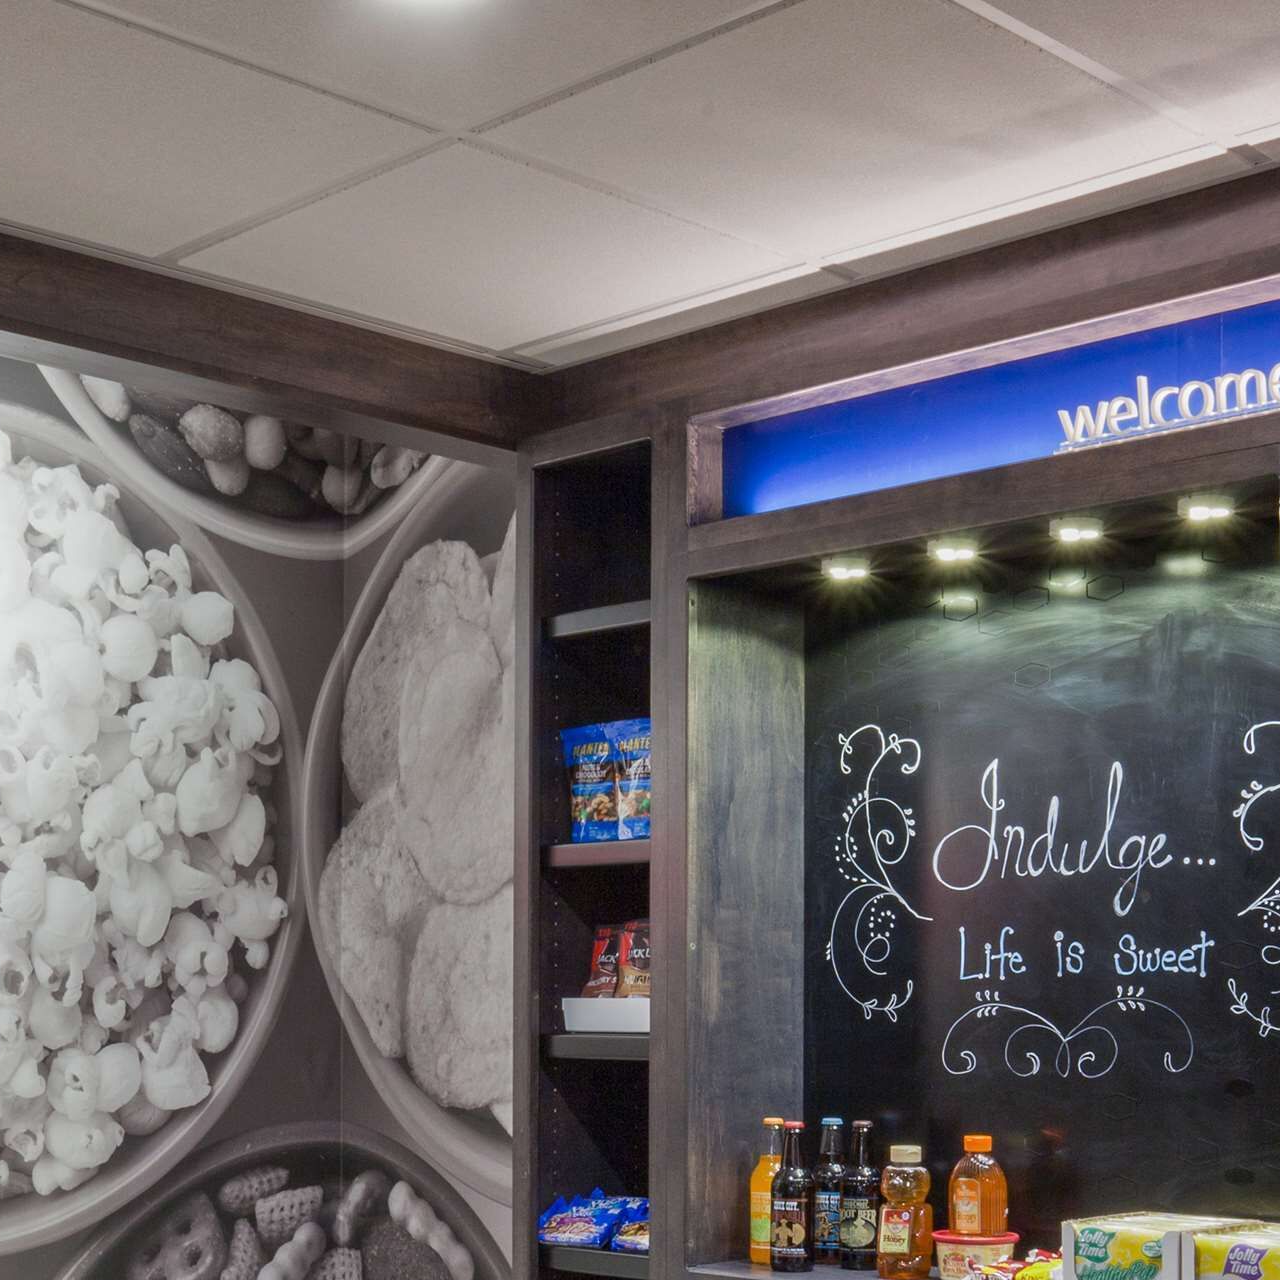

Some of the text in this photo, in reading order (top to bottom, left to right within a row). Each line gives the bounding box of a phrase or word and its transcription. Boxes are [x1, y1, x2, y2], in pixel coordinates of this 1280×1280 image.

[959, 927, 1214, 980] Life is Sweet
[1080, 1229, 1108, 1246] Jolly
[1079, 1243, 1105, 1257] Time
[1230, 1248, 1260, 1263] Jolly
[1230, 1261, 1258, 1275] Time
